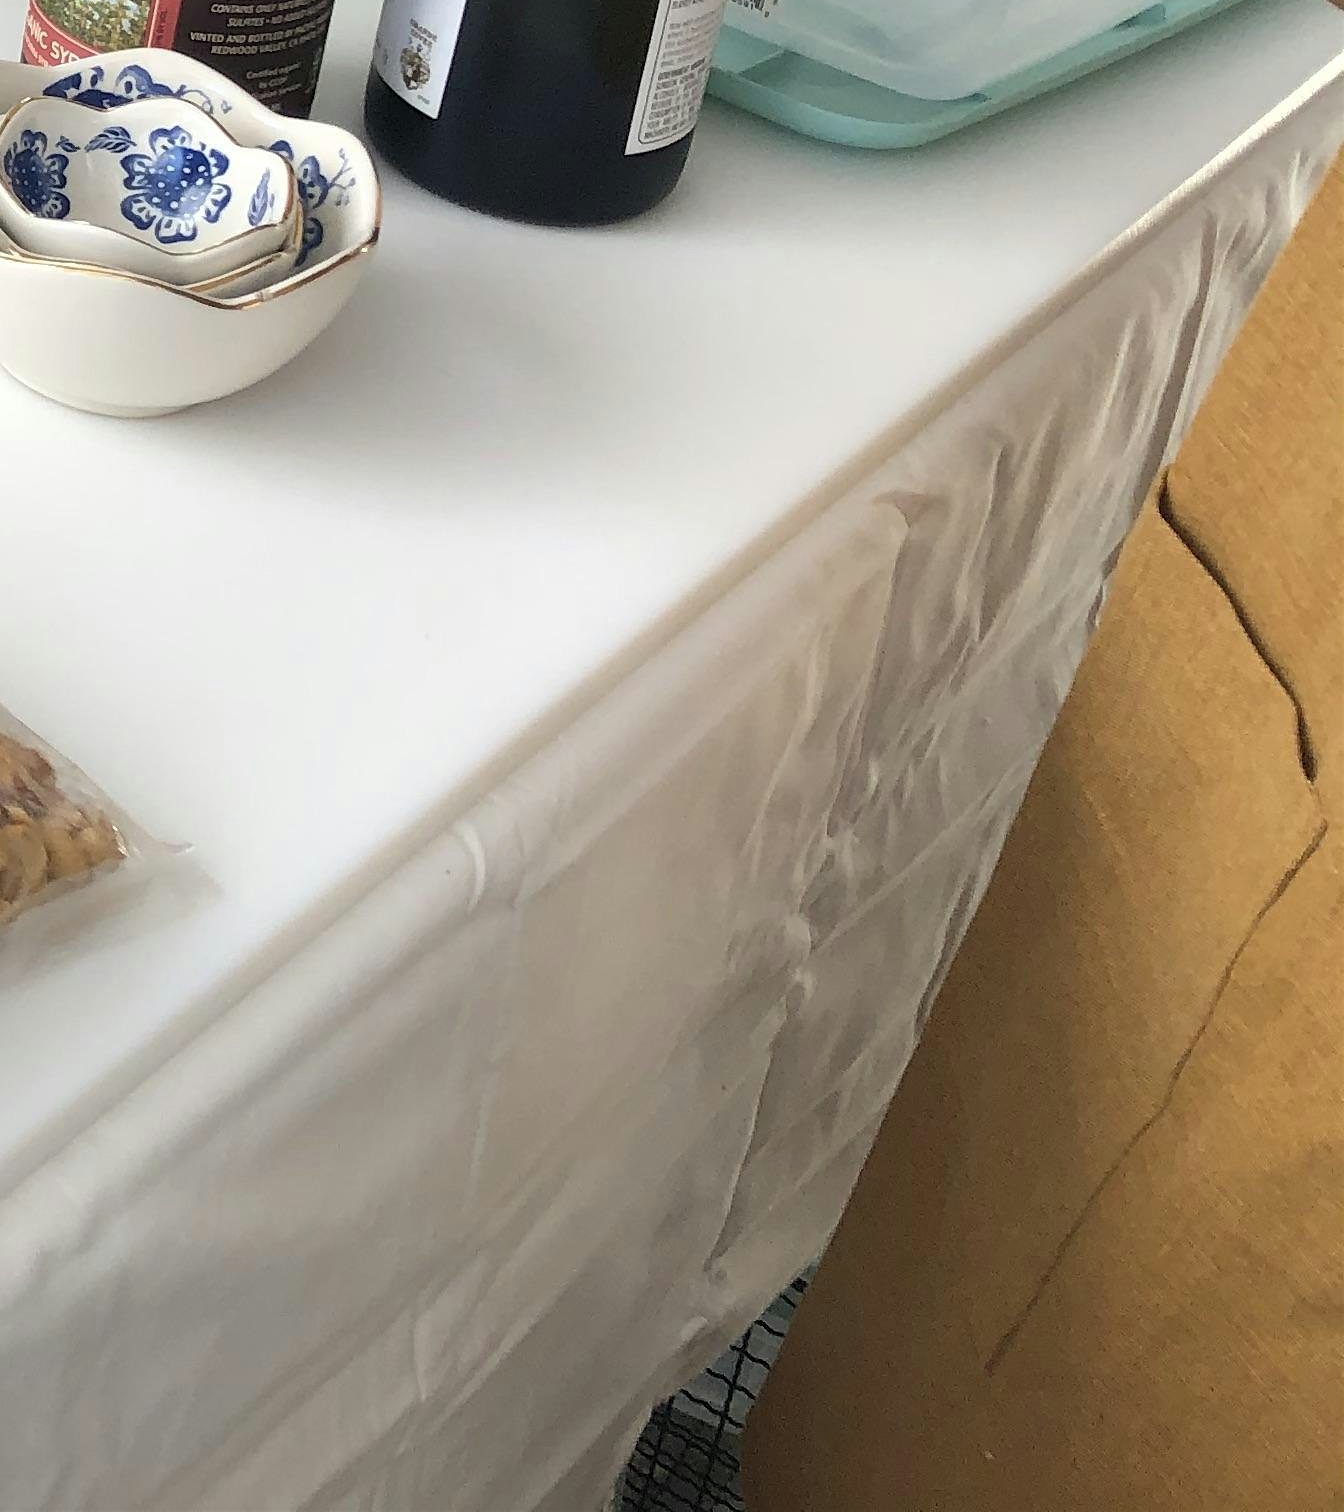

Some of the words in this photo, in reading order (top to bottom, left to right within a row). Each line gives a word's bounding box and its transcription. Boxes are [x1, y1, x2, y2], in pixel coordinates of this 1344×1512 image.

[26, 13, 48, 50] ANIC
[190, 31, 225, 43] VINTED
[226, 34, 246, 44] AND
